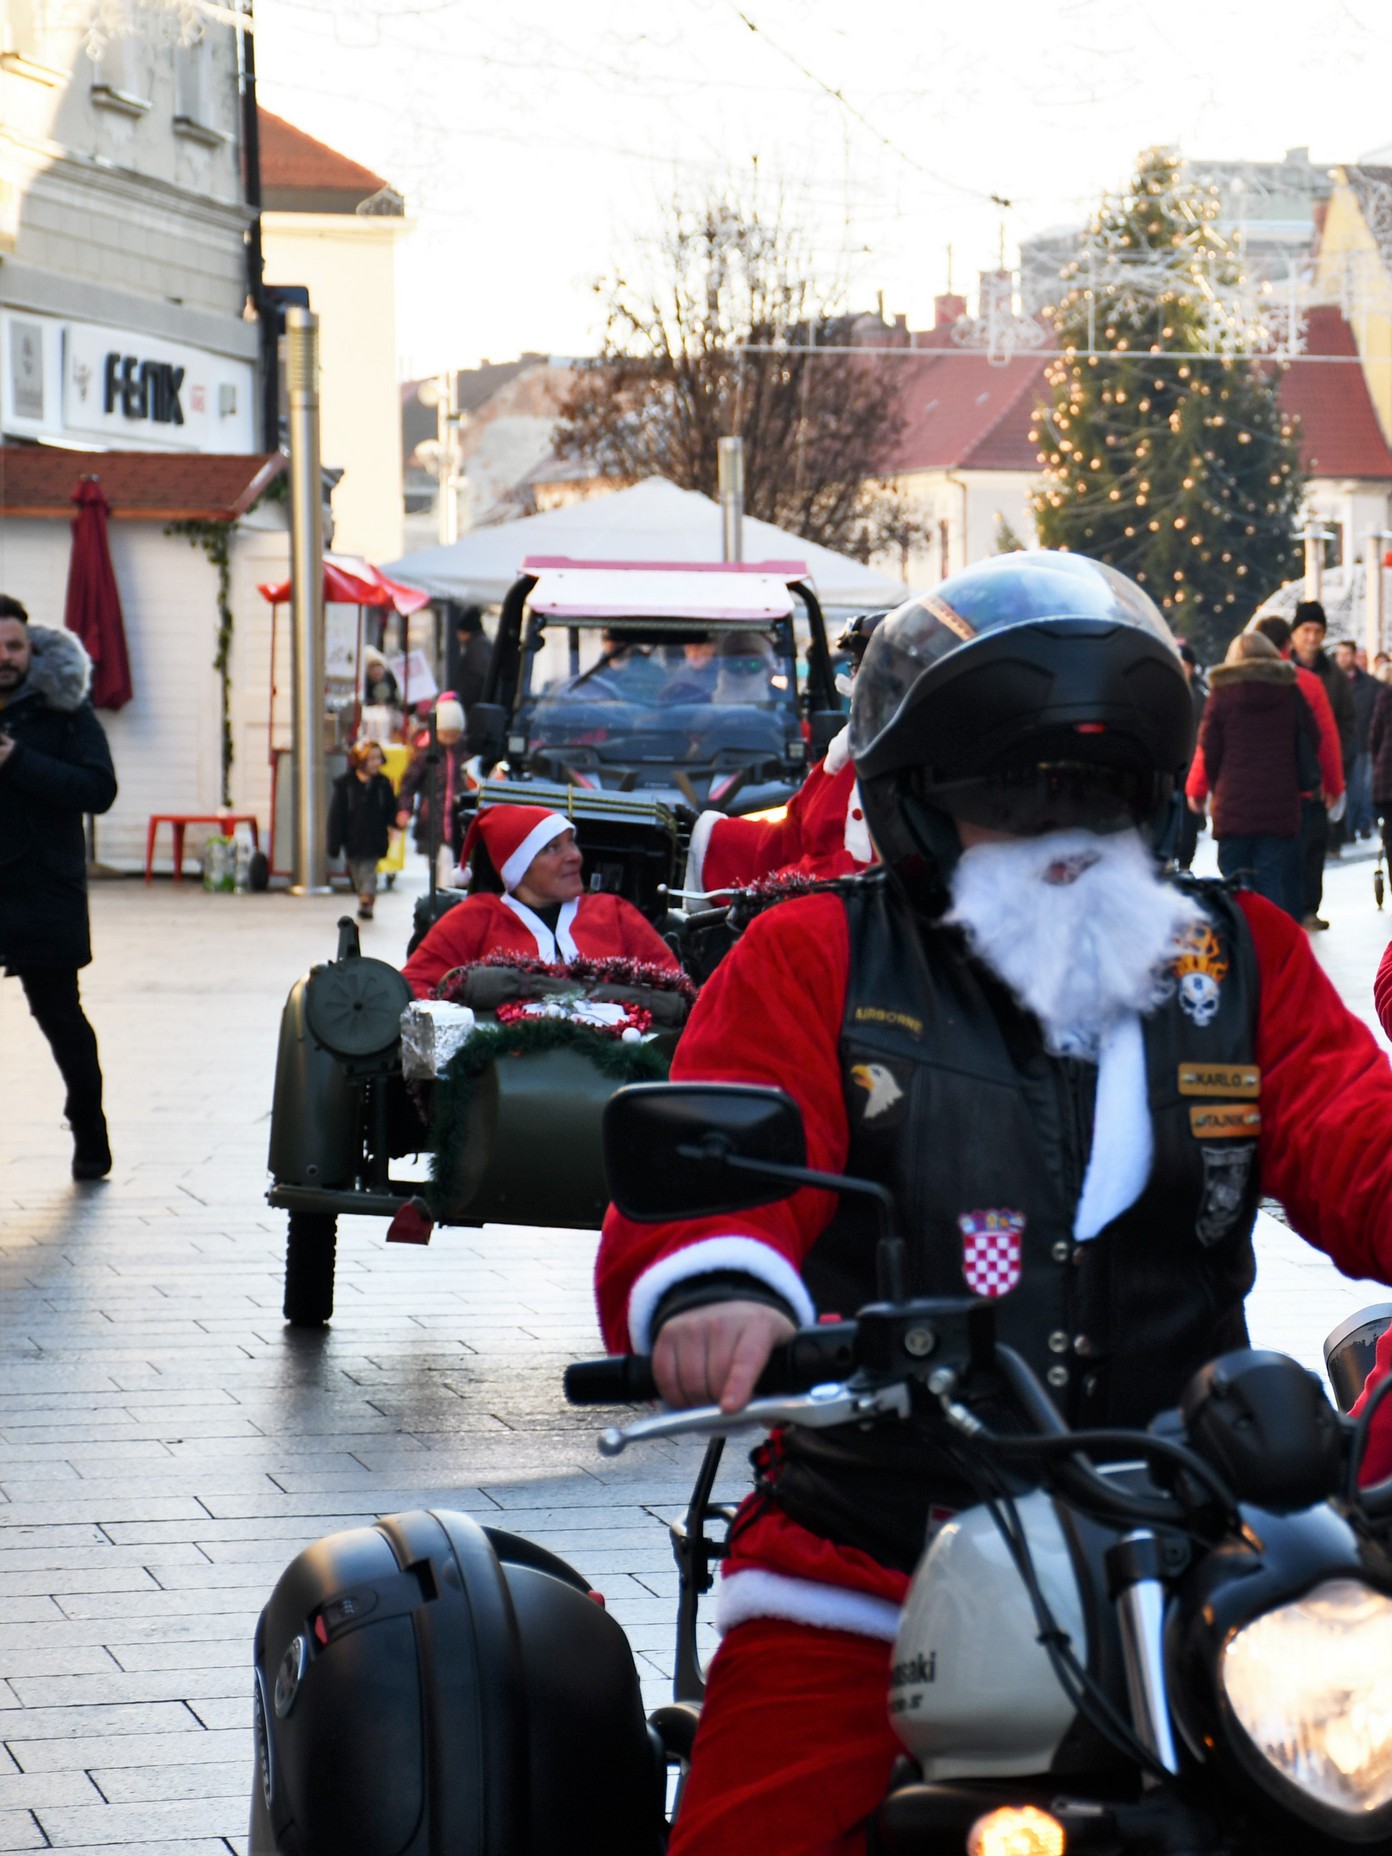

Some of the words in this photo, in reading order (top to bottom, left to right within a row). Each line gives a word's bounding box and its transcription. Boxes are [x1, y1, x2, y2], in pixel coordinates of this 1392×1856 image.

[104, 351, 184, 425] FENIX
[855, 1006, 923, 1035] AIRBORNE
[1195, 1072, 1243, 1088] KARLO
